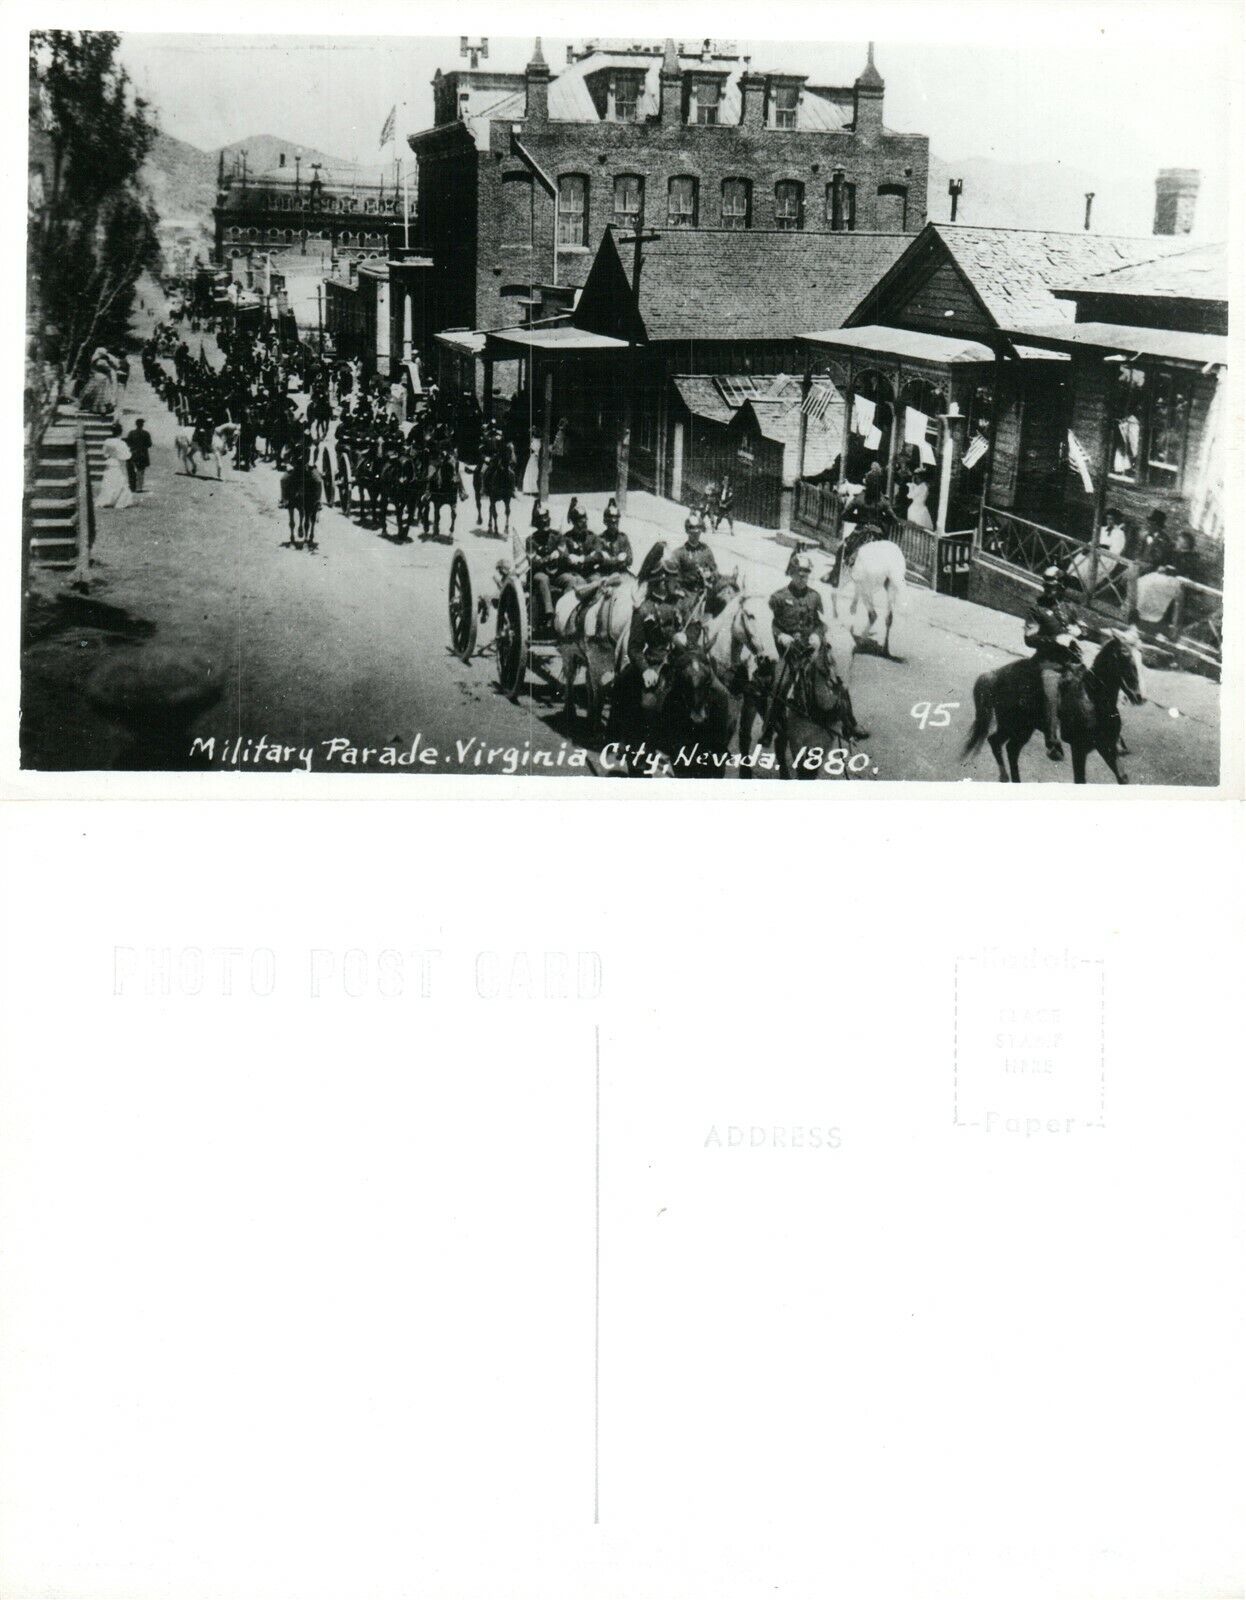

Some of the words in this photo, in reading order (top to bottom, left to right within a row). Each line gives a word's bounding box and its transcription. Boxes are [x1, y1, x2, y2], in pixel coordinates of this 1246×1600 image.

[111, 944, 278, 998] PHOTO
[309, 947, 443, 1000] POST
[473, 950, 604, 1000] CARD
[703, 1124, 843, 1149] ADDRESS
[984, 1111, 1077, 1139] Paper
